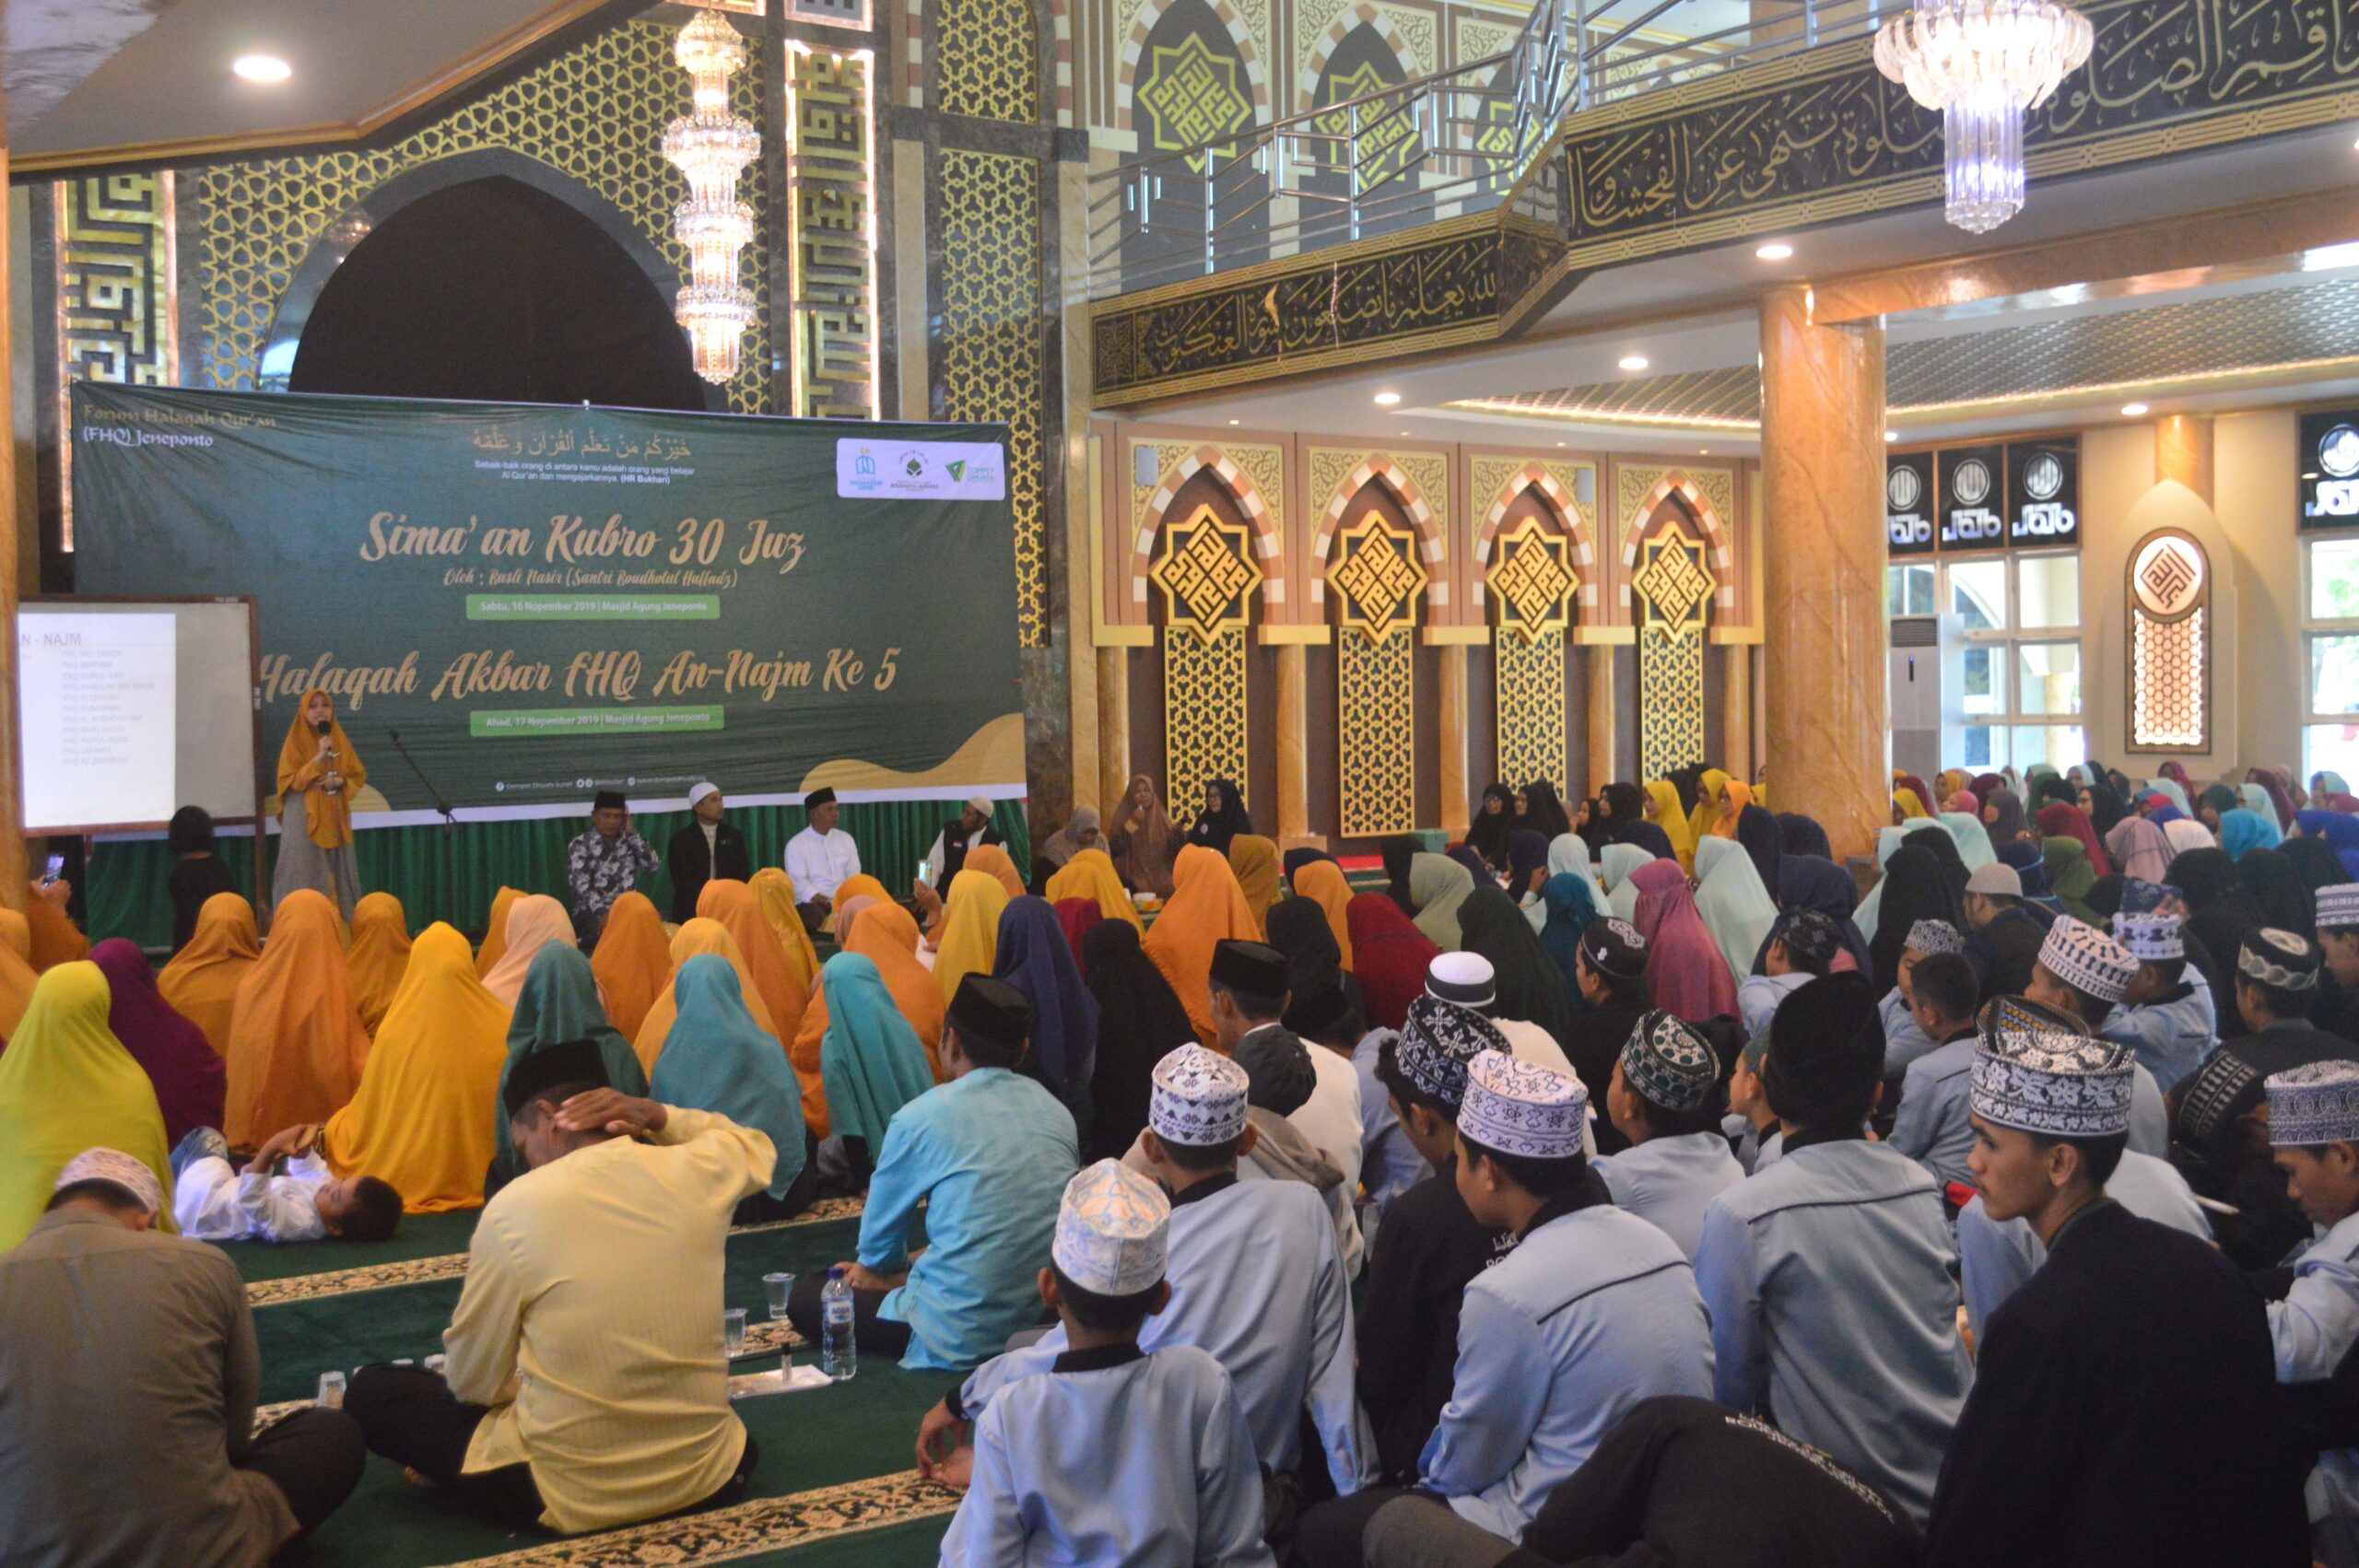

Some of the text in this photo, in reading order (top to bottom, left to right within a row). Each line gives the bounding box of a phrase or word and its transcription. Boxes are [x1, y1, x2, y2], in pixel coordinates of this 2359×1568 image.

[146, 409, 215, 428] Halaqah
[220, 411, 276, 429] Qur'an
[83, 426, 214, 448] (FHQ) Jeneponto
[475, 460, 695, 476] Sebaik-baik orang di antara kamu adalah orang yang belajar
[540, 472, 554, 480] dan
[620, 475, 636, 485] (HR
[638, 475, 670, 486] Bukhari)
[359, 511, 806, 575] Sima'an Kubro 30 Juz
[444, 568, 474, 586] Oleh
[489, 568, 522, 585] Rusli
[526, 568, 561, 586] Nasir
[566, 568, 613, 587] (Santri
[481, 601, 510, 613] Sabtu,
[511, 602, 523, 611] 16
[524, 602, 572, 614] Nopember
[574, 602, 596, 612] 2019
[603, 601, 631, 614] Masjid
[633, 603, 661, 614] Agung
[663, 603, 707, 614] Jeneponto
[43, 634, 81, 645] NAJM
[259, 649, 420, 711] Halaqah
[430, 649, 553, 702] Akbar
[563, 649, 641, 702] FHQ
[652, 648, 815, 703] An-Najm
[823, 648, 866, 692] Ke
[874, 647, 902, 692] 5
[487, 716, 511, 727] Ahad,
[515, 717, 525, 726] 17
[527, 716, 576, 727] Nopember
[577, 715, 598, 725] 2019
[605, 714, 634, 725] Masjid
[636, 714, 664, 725] Agung
[665, 712, 710, 723] Jeneponto
